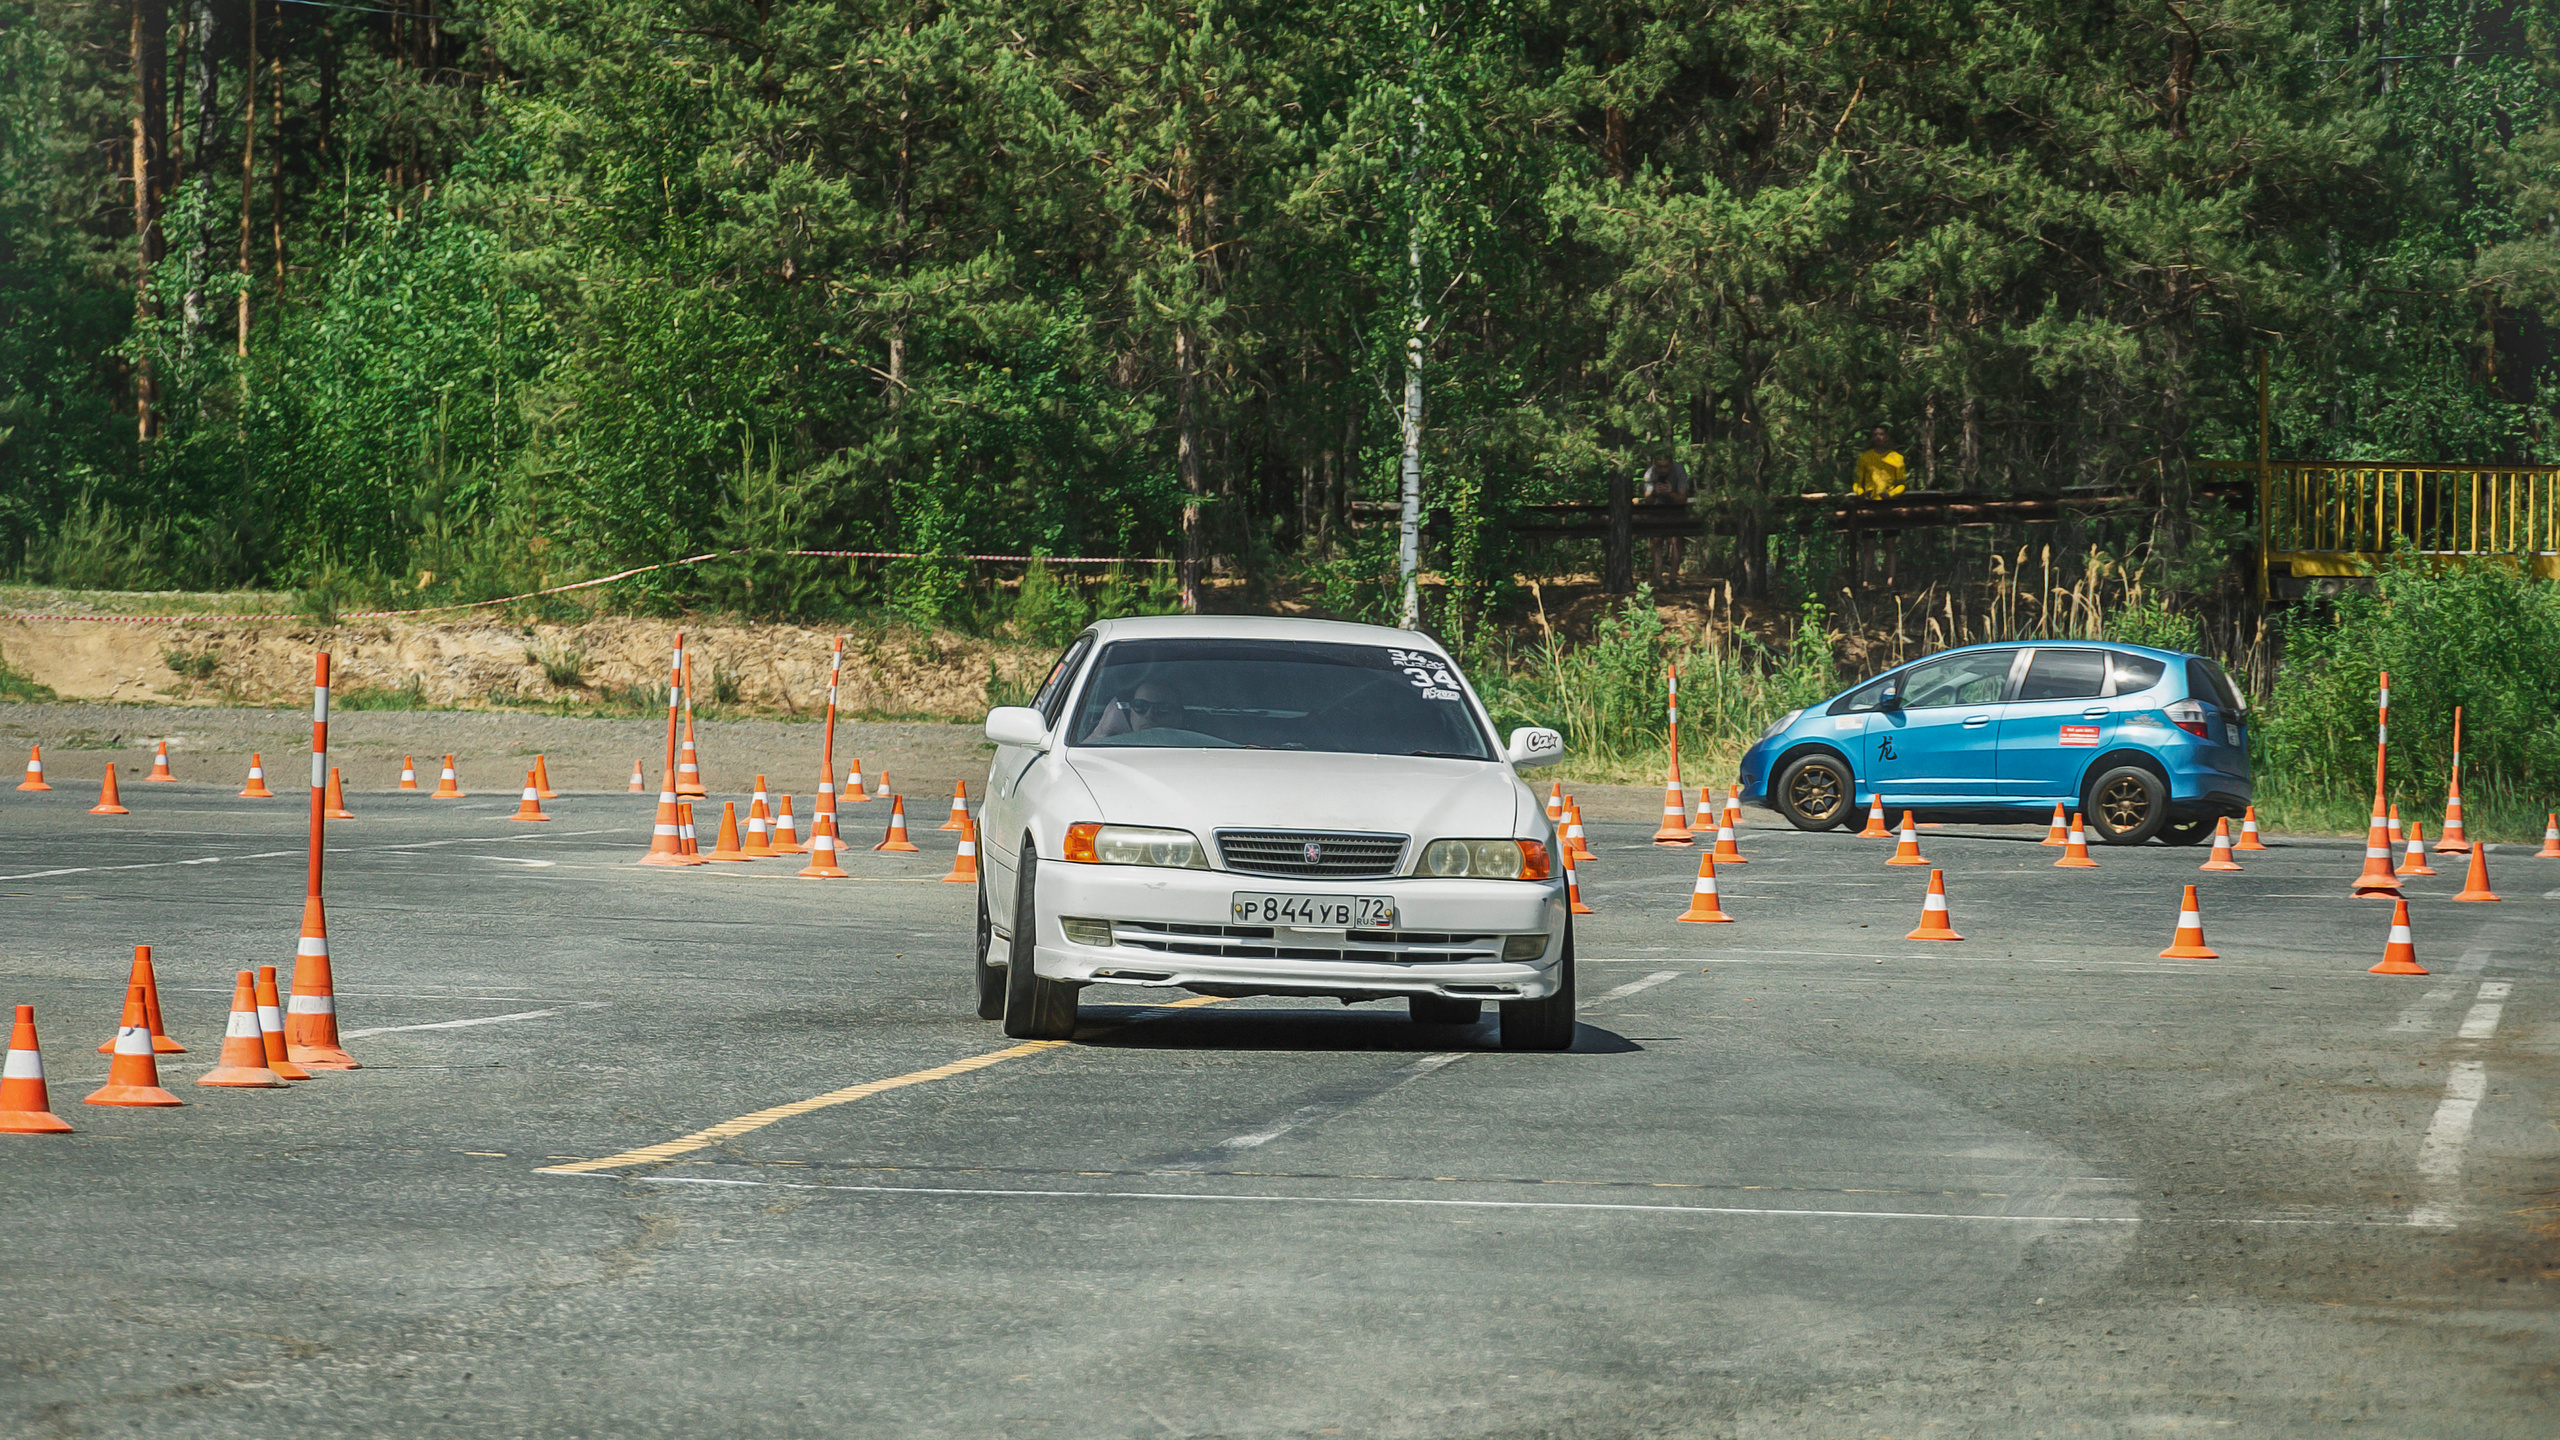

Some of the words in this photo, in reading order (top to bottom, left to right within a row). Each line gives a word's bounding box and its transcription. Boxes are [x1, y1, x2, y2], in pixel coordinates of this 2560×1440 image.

[1387, 648, 1428, 664] 34
[1402, 667, 1461, 691] 34
[1358, 899, 1385, 919] 72
[1356, 917, 1376, 926] RUS
